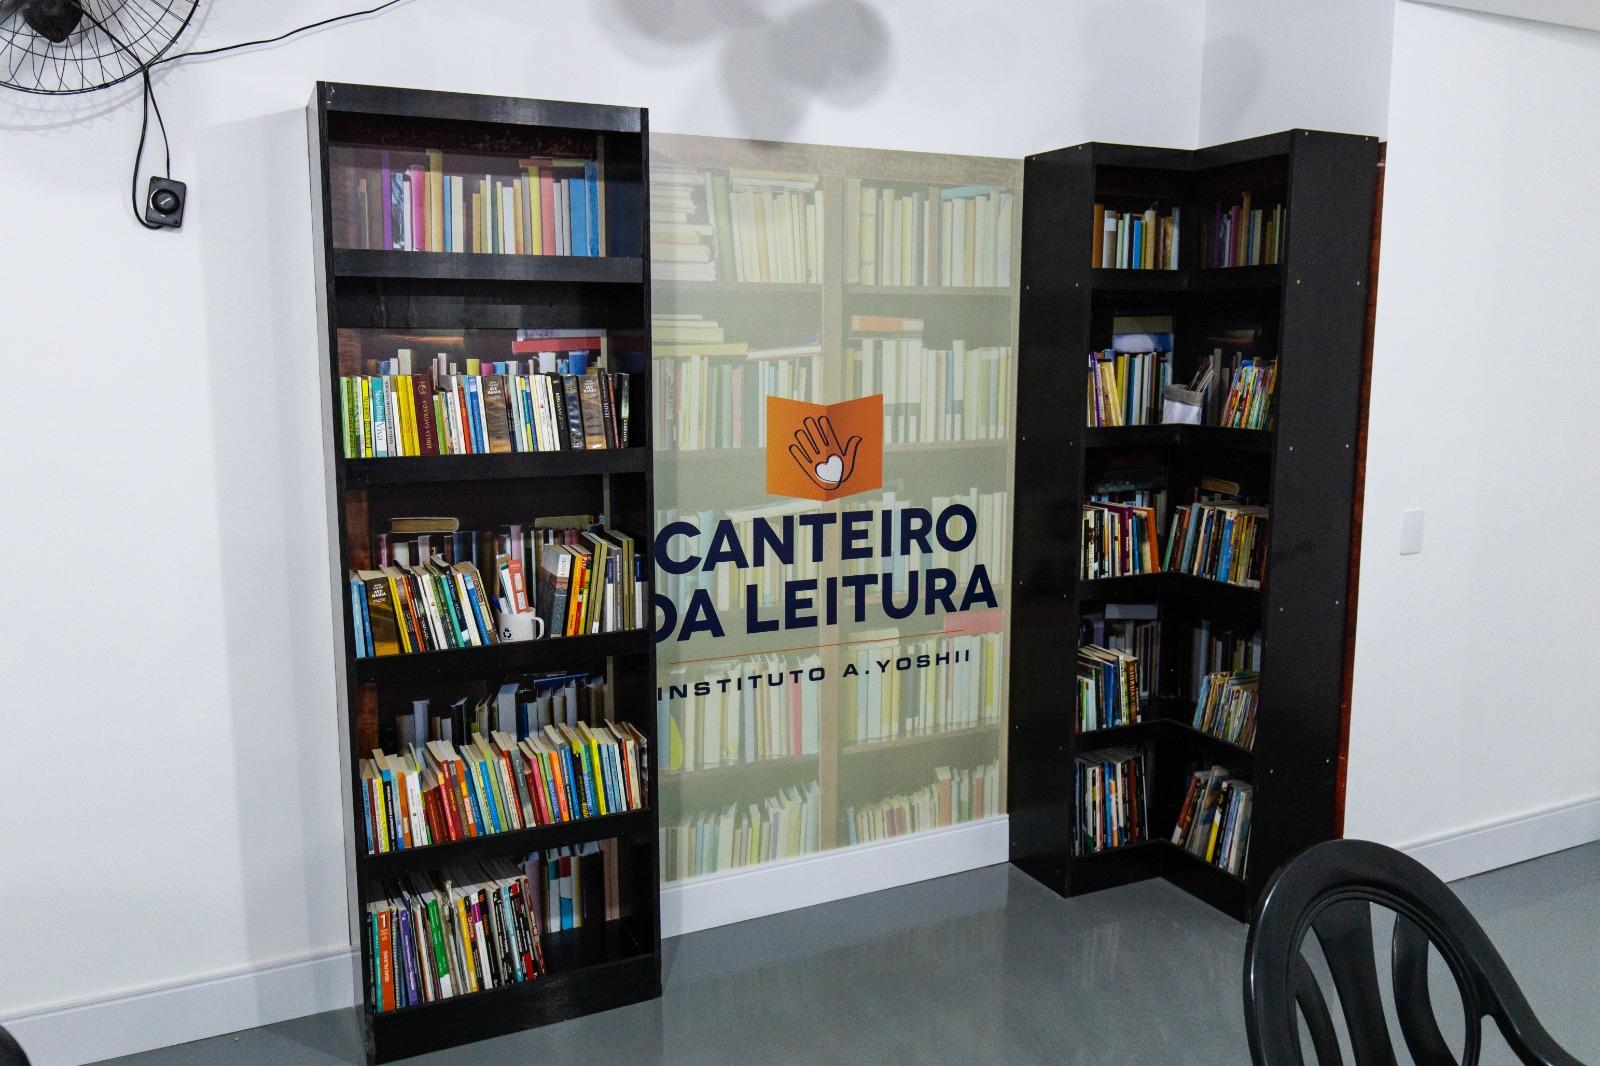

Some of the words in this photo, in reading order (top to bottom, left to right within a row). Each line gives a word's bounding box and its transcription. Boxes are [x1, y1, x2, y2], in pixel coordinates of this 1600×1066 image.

[654, 504, 977, 575] CANTEIRO
[746, 564, 998, 635] LEITURA
[657, 667, 826, 701] INSTITUTO
